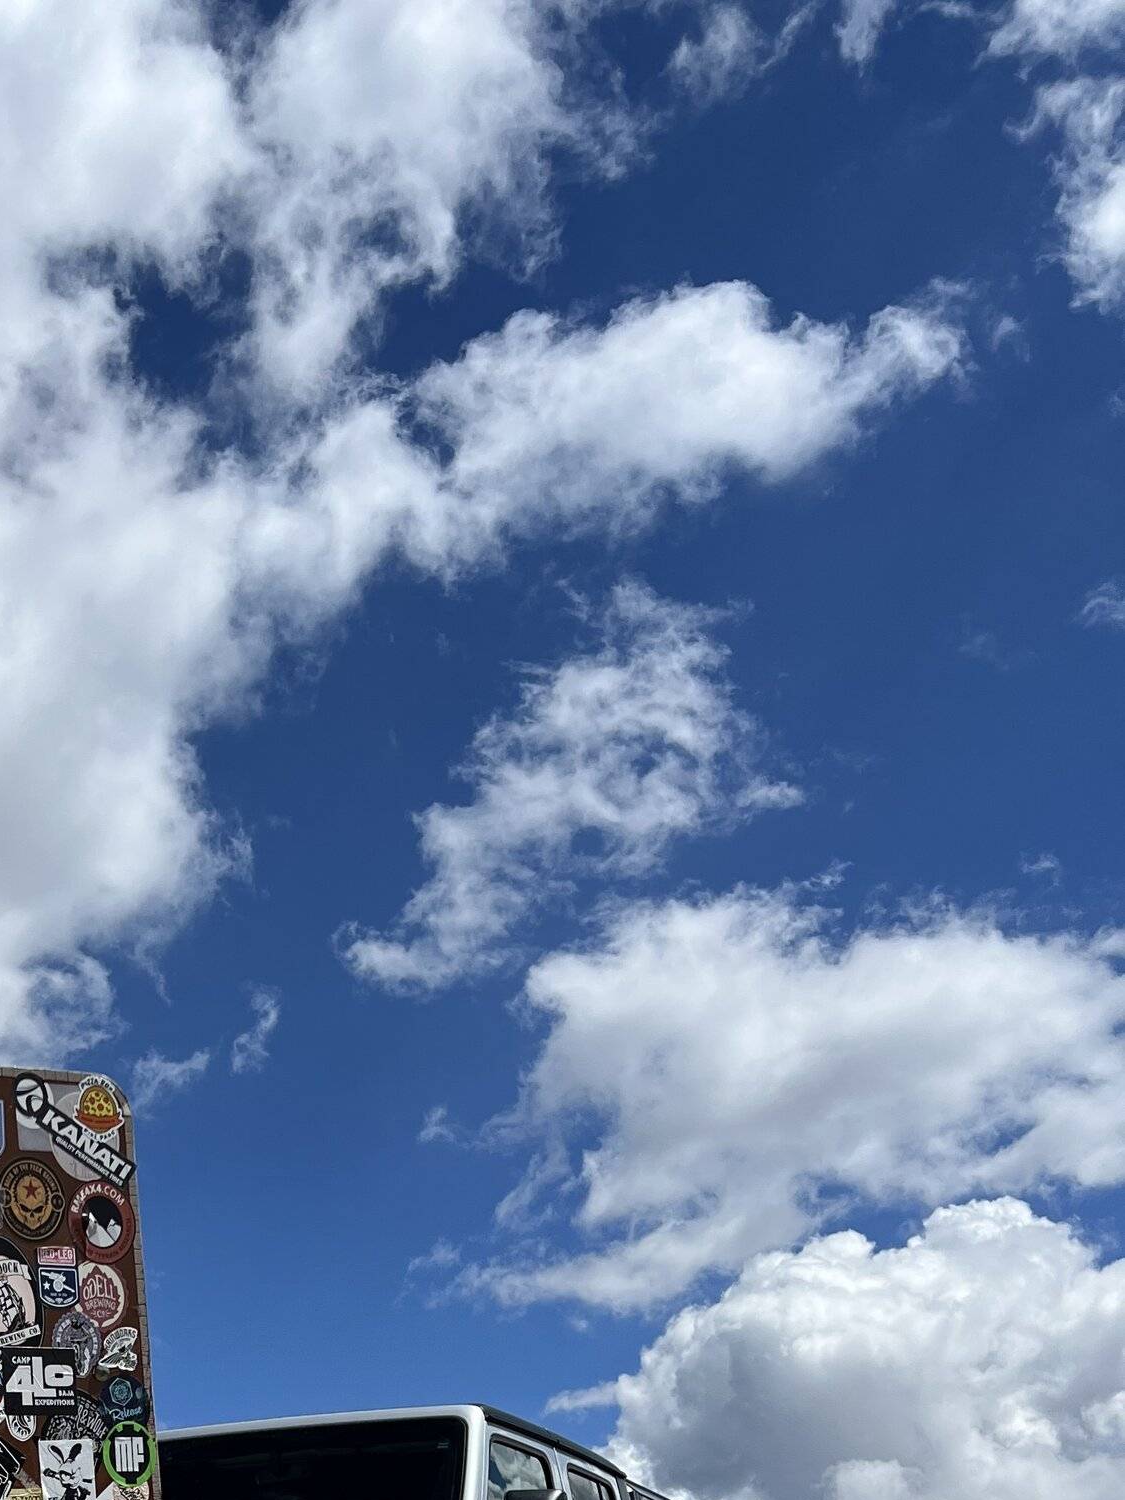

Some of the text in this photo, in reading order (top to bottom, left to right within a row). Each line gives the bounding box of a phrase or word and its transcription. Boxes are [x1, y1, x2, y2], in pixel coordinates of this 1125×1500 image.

[41, 1109, 133, 1181] KANATI
[82, 1273, 117, 1301] ODELL
[85, 1298, 117, 1312] BREWING
[11, 1355, 31, 1365] CAMP
[57, 1389, 75, 1398] BAJA
[33, 1398, 75, 1407] EXPEDITIONS
[114, 1436, 146, 1472] MF
